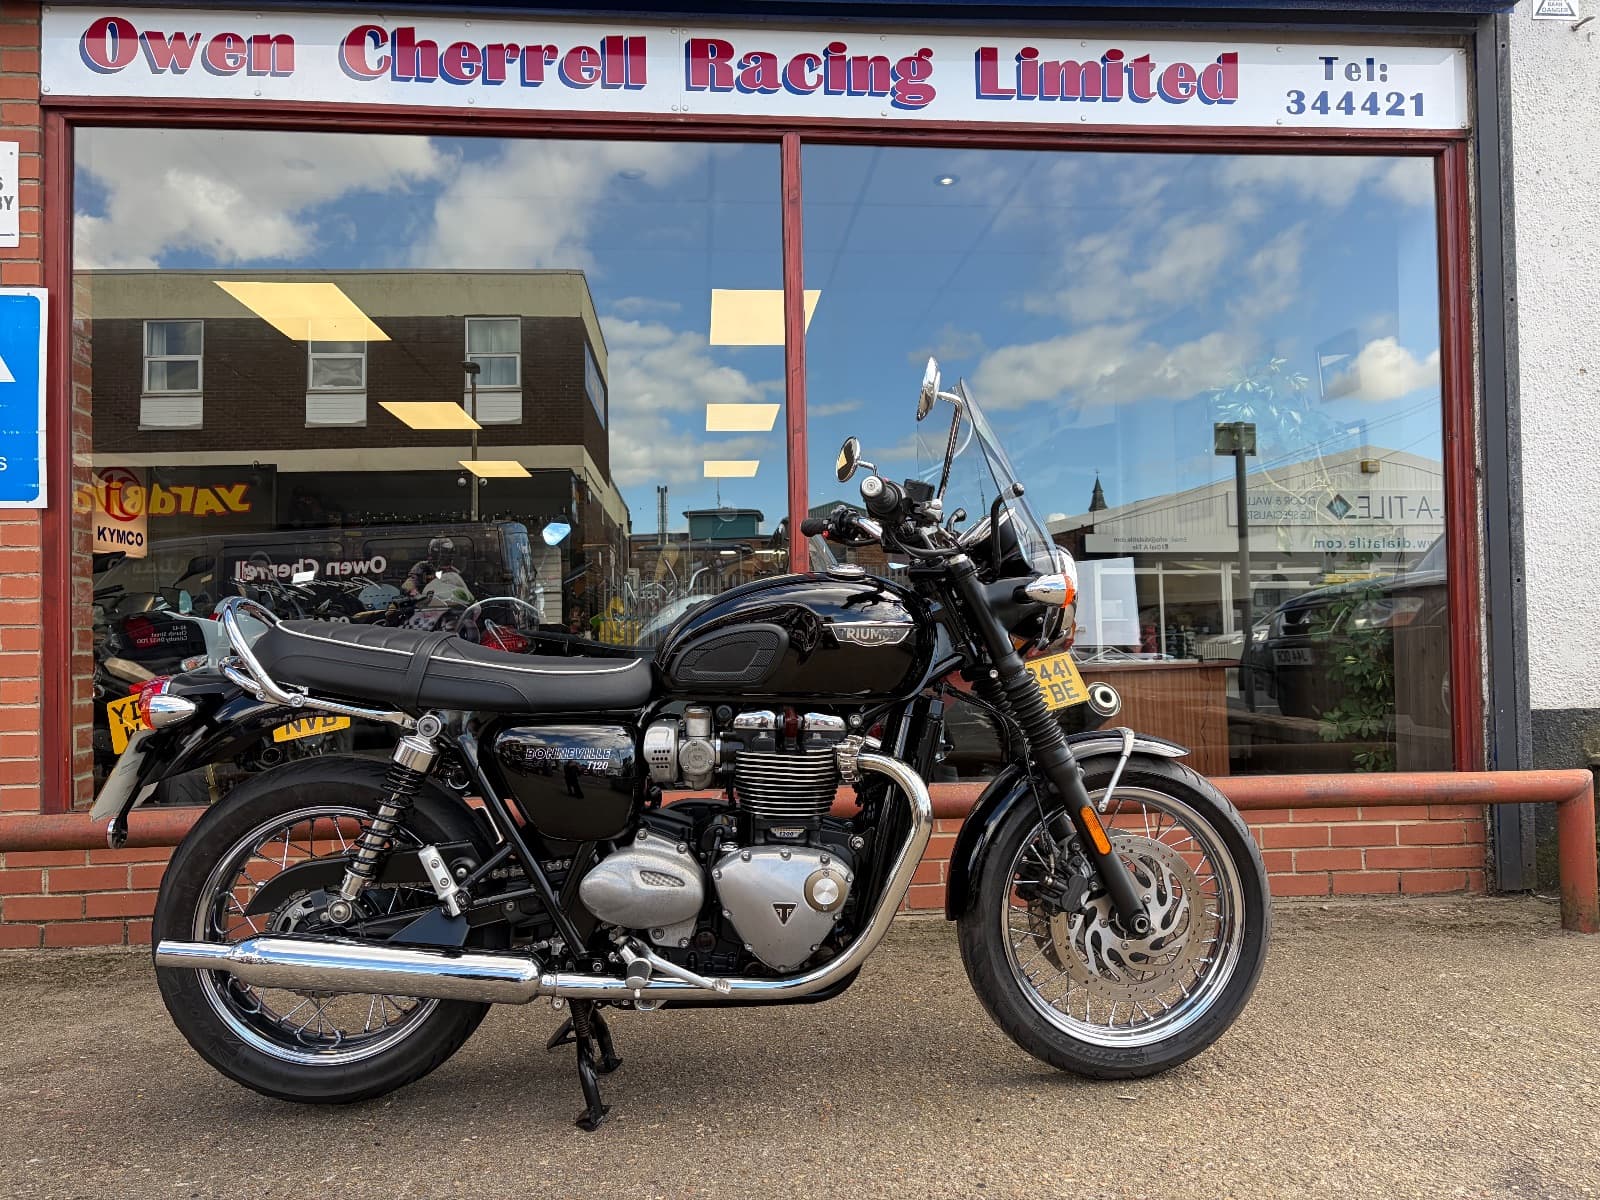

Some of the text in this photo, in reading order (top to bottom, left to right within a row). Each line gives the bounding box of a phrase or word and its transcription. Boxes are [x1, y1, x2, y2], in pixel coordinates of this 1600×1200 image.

[79, 16, 1239, 110] Owen Cherrell Racing Limited
[1318, 56, 1388, 82] Tel:
[1285, 89, 1425, 117] 344421
[97, 526, 144, 546] KYMCO
[525, 747, 612, 760] BONNEVILLE
[587, 760, 609, 770] T120
